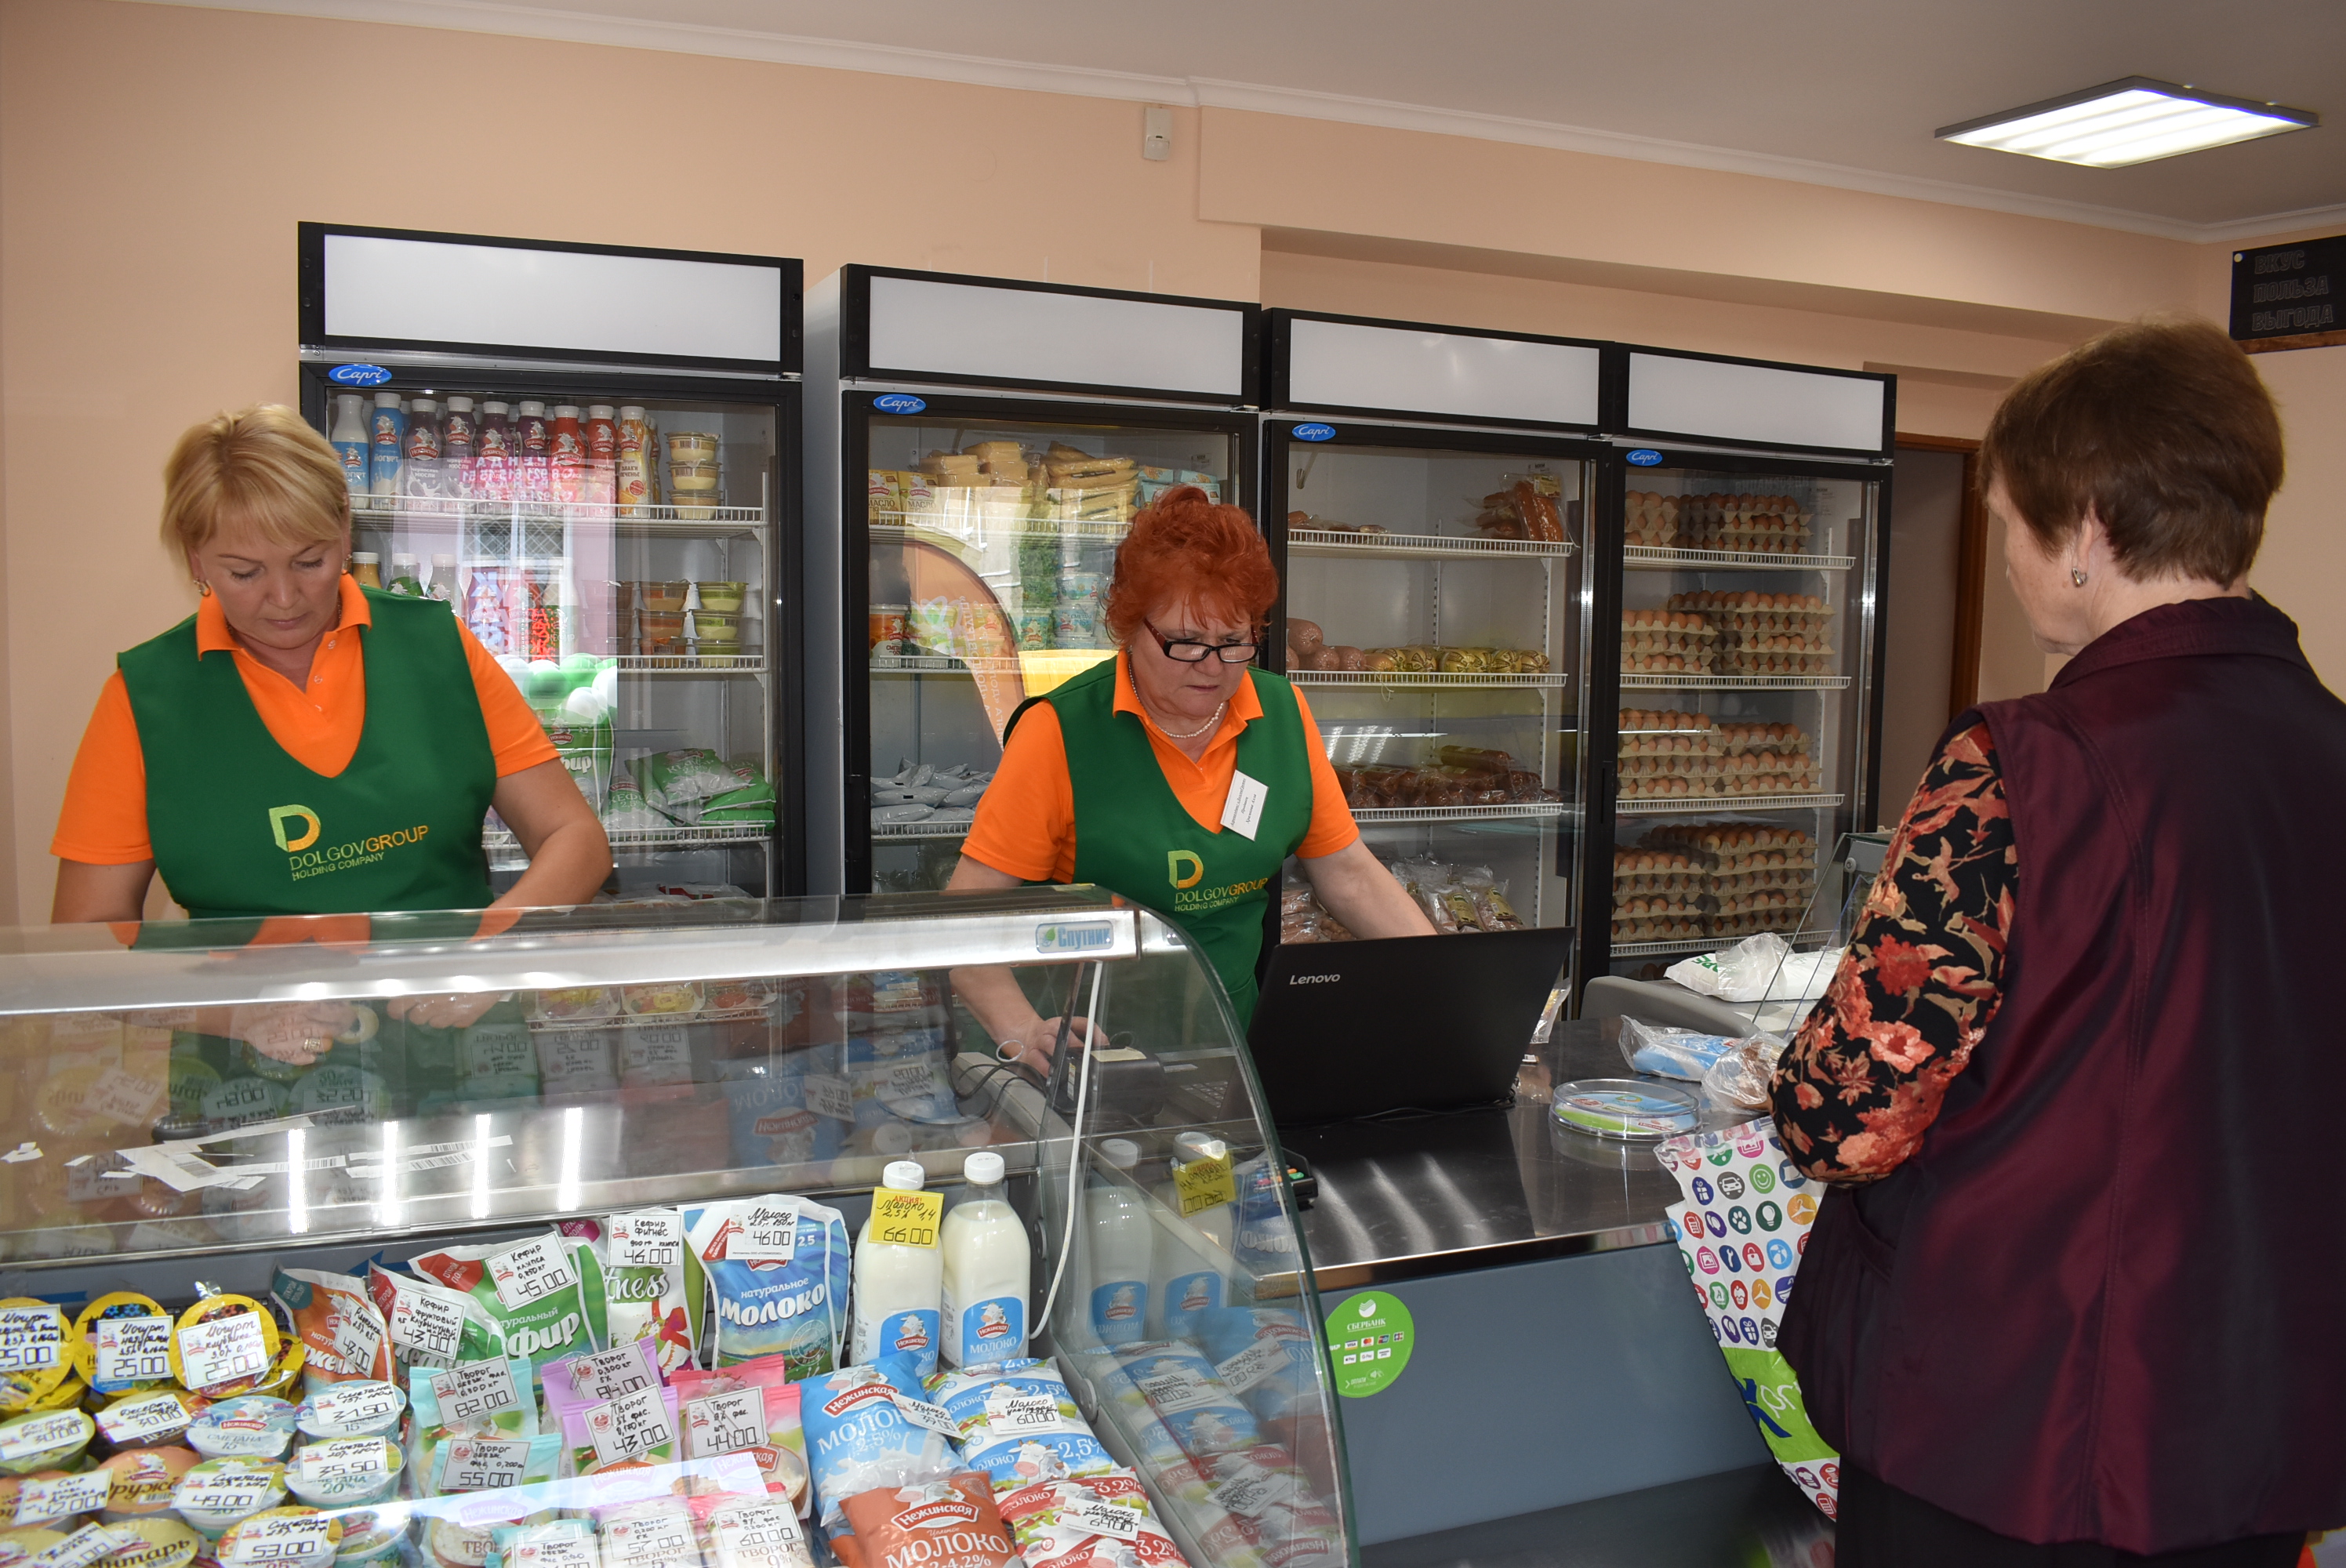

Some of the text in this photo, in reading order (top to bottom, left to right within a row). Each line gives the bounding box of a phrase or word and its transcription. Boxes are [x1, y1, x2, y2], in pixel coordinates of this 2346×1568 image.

[2254, 250, 2304, 274] ВКУС
[2253, 276, 2329, 303] ПОЛЬЗА
[2252, 304, 2333, 331] ВЫГОДА
[337, 368, 382, 385] Capri
[880, 397, 918, 412] Capri
[1298, 426, 1330, 440] Capri
[1632, 452, 1658, 464] Capri
[292, 851, 385, 881] HOLDING COMPANY
[1175, 896, 1240, 912] HOLDING COMPANY
[1059, 927, 1111, 949] Спутник
[1289, 974, 1341, 985] Lenovo
[876, 1199, 925, 1211] Молоко
[892, 1195, 923, 1204] АКЦИЯ!
[747, 1207, 792, 1220] Молоко
[740, 1277, 809, 1299] натуральное
[499, 1306, 559, 1329] туральный
[1346, 1317, 1386, 1332] СБЕРБАНК
[507, 1312, 580, 1359] фир
[969, 1336, 1017, 1355] МОЛОКО
[827, 1385, 895, 1413] Нежинская
[950, 1394, 986, 1414] ОЛОКО
[1004, 1398, 1048, 1410] Молоко
[717, 1452, 774, 1472] Нежинская
[594, 1465, 652, 1483] Нежинская
[463, 1504, 525, 1520] Нежинская
[899, 1504, 973, 1526] Нежинская
[1086, 1504, 1136, 1518] Молоко
[623, 1546, 686, 1566] ТВОРОГ
[738, 1542, 798, 1559] ТВОРОГ
[884, 1532, 1009, 1568] МОЛОКО
